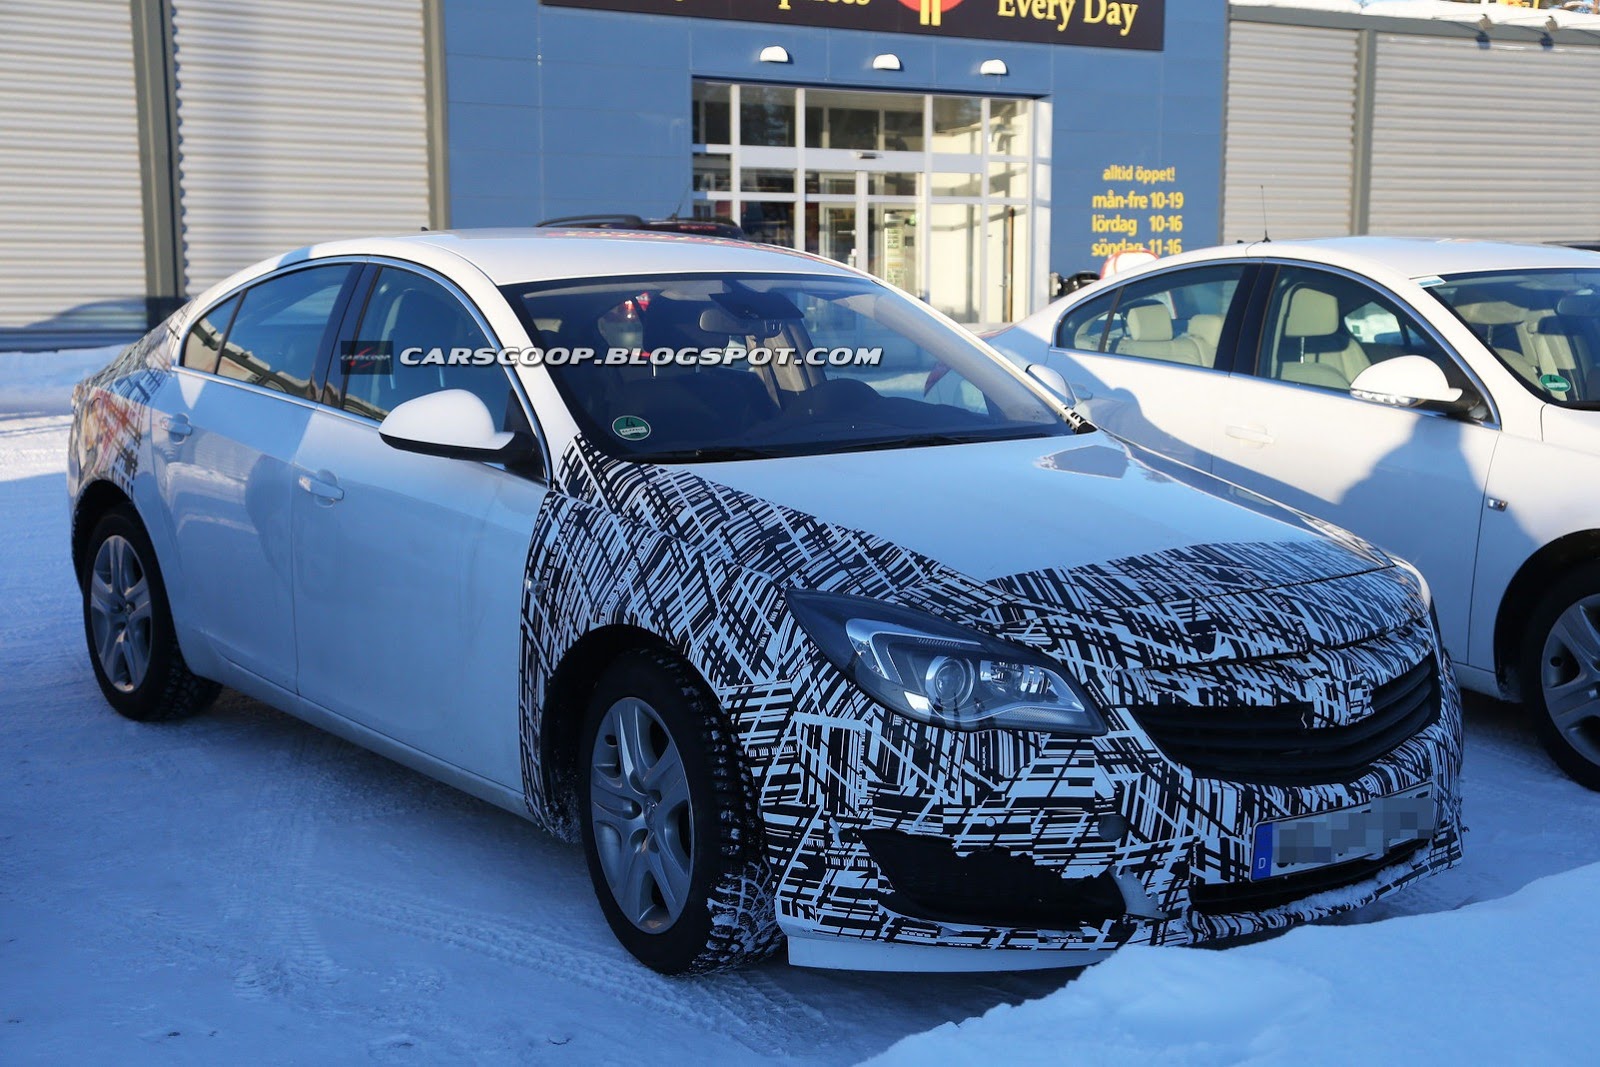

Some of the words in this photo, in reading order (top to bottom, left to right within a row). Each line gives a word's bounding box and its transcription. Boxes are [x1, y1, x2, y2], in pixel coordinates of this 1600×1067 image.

[997, 0, 1076, 32] Every
[1083, 0, 1139, 37] Day
[1103, 164, 1134, 181] alltid
[1135, 165, 1176, 184] öppet!
[1092, 189, 1148, 209] mån-fre
[1149, 191, 1184, 209] 10-19
[1092, 214, 1138, 236] lördag
[1149, 215, 1183, 232] 10-16
[1148, 238, 1182, 255] 11-16
[1257, 857, 1267, 869] D
